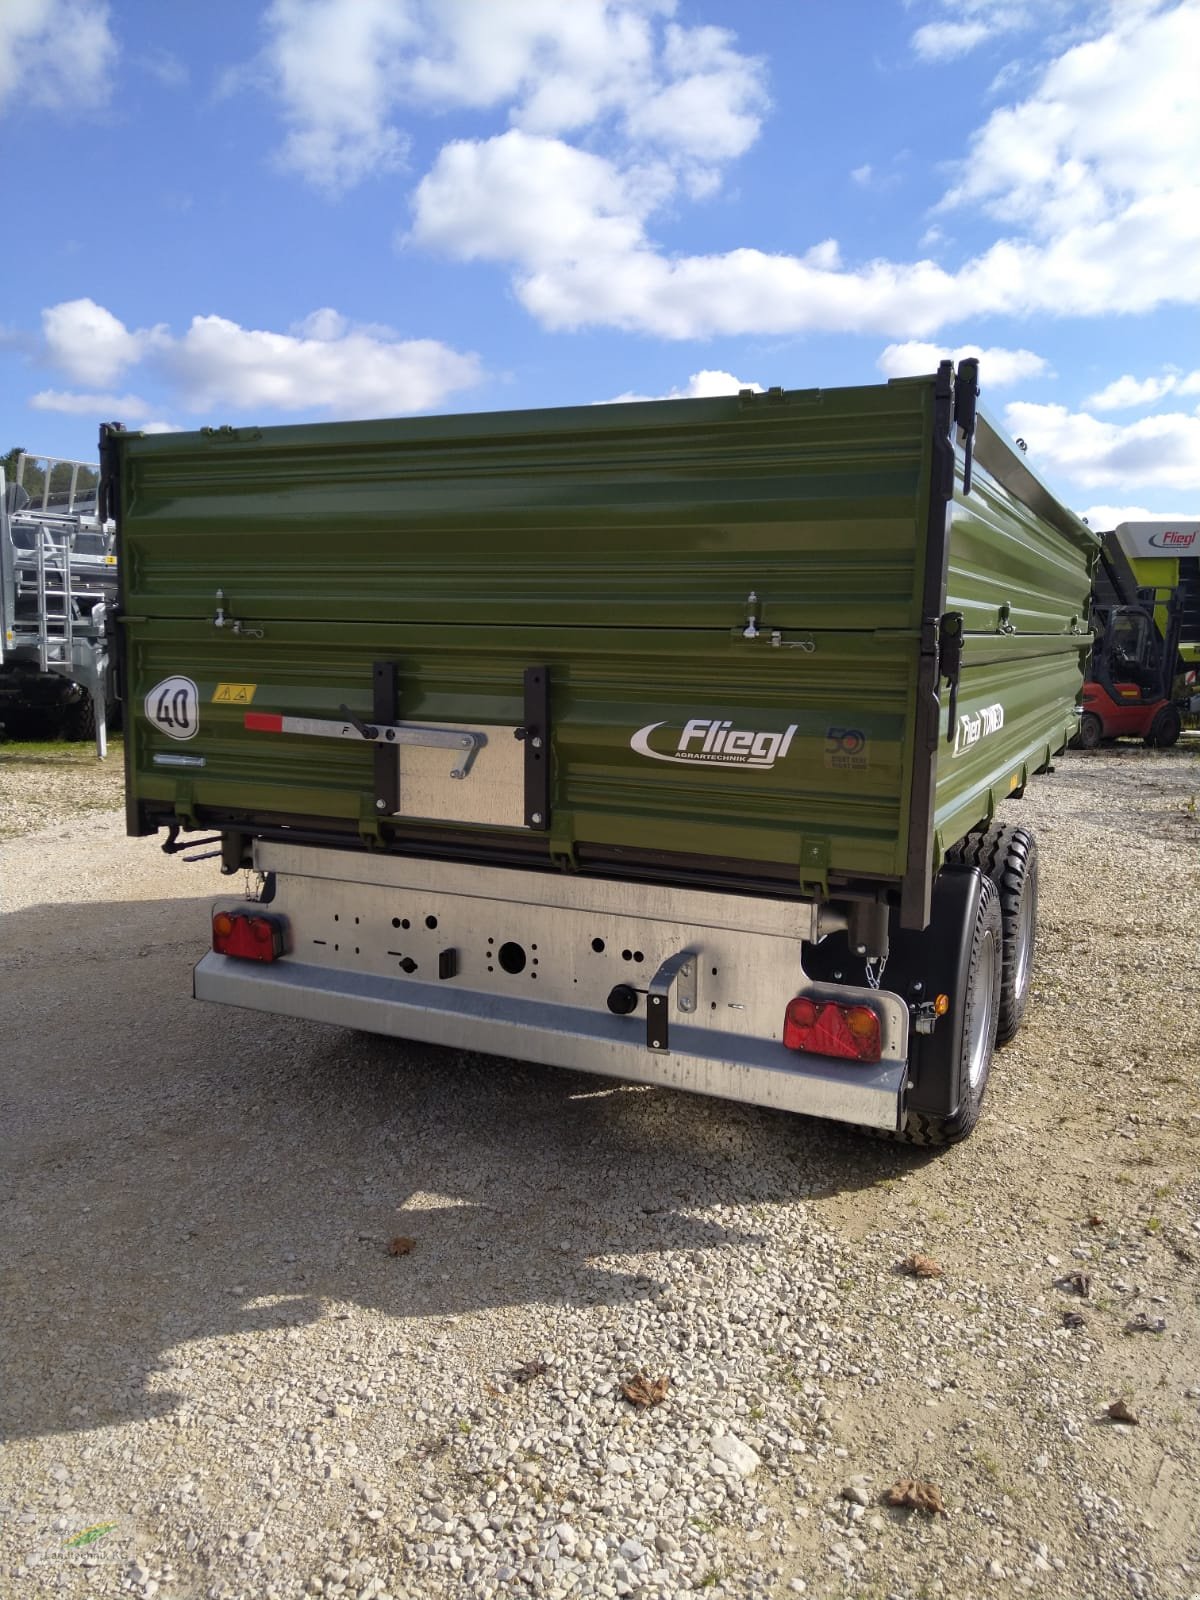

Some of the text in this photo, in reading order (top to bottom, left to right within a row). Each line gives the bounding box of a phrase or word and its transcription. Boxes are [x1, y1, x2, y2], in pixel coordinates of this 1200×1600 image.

[1162, 531, 1196, 549] Fliegl
[156, 689, 189, 729] 40
[677, 719, 799, 764] Fliegl
[675, 752, 748, 762] AGRARTECHNIK
